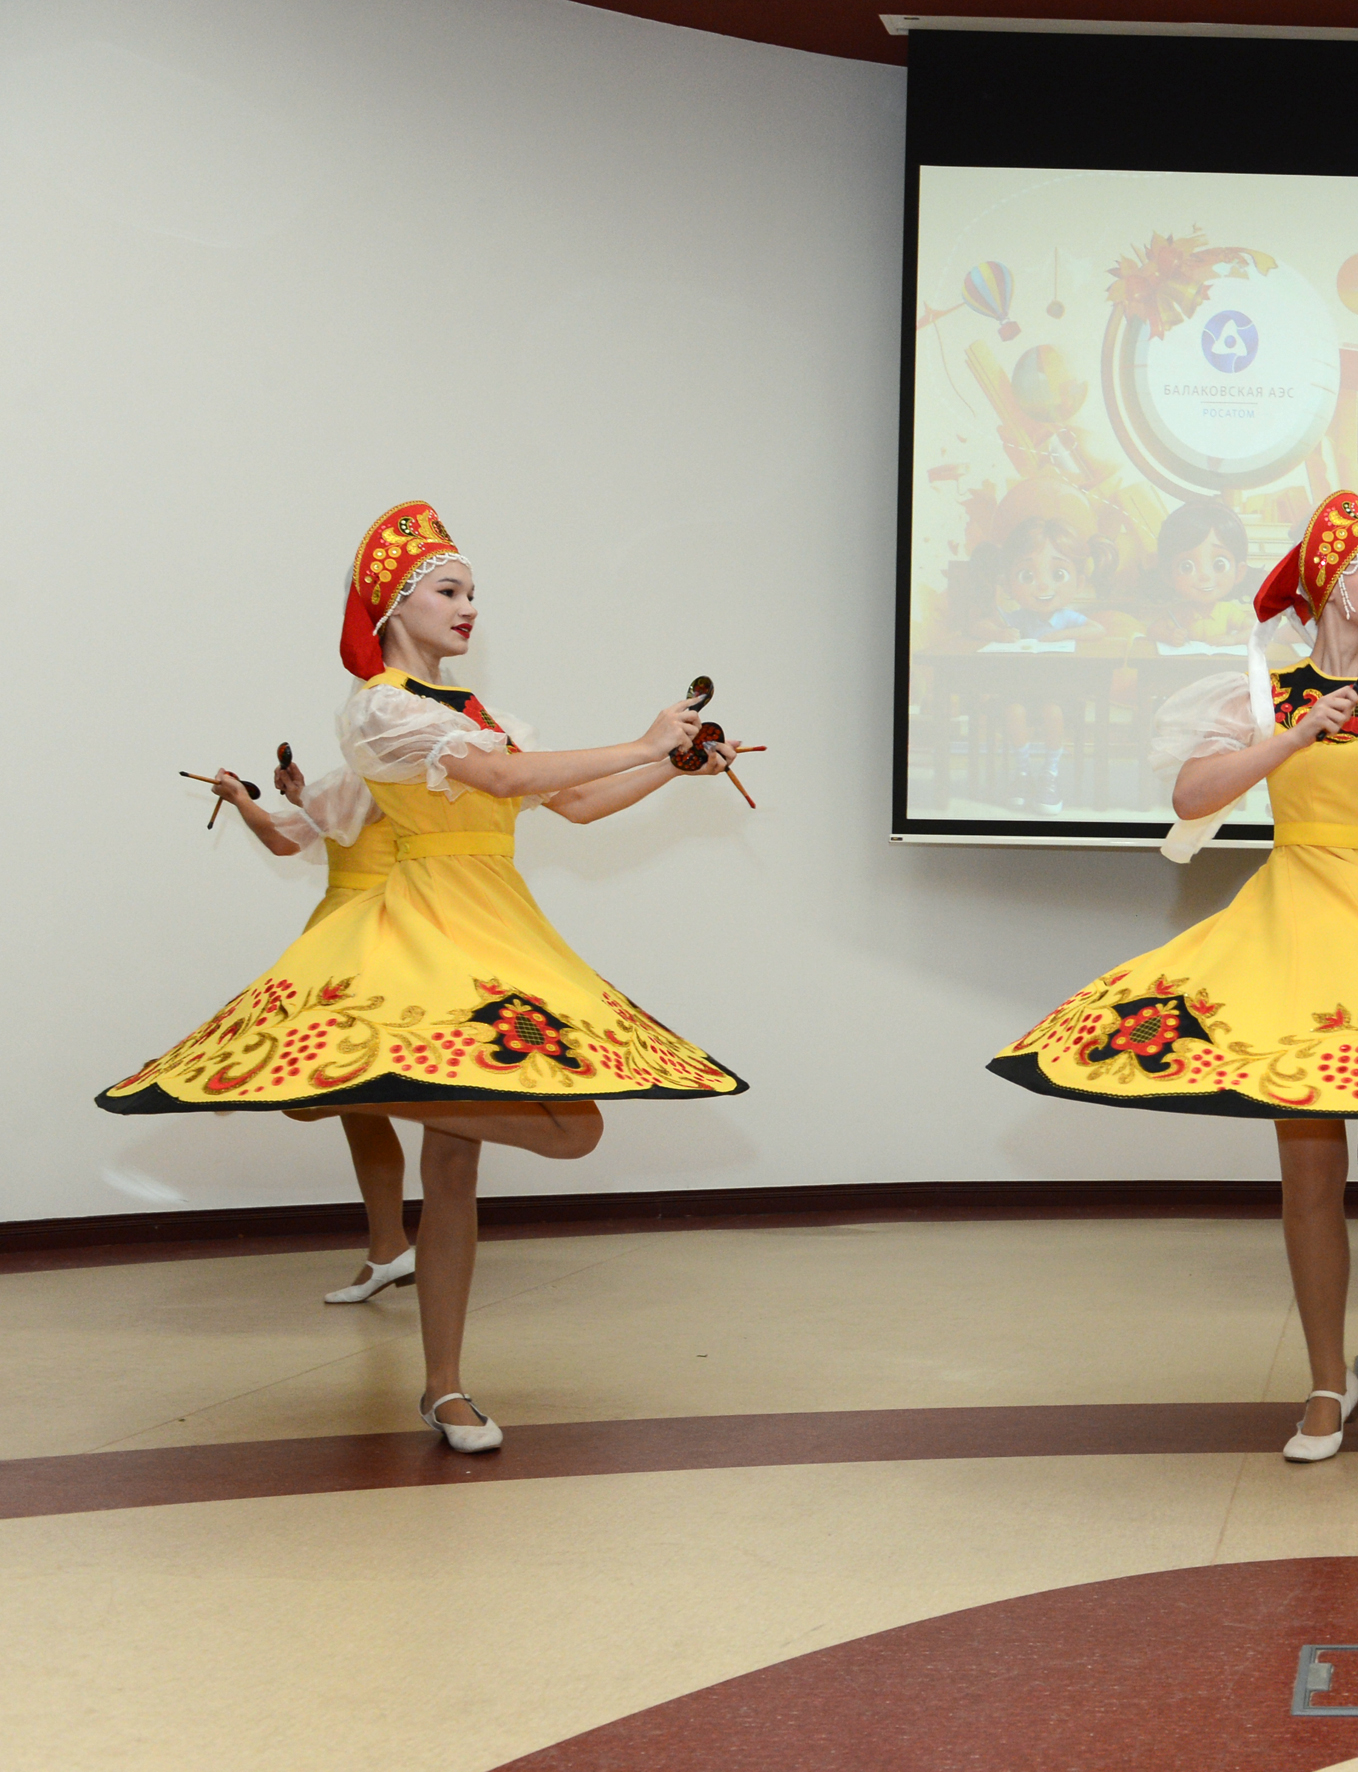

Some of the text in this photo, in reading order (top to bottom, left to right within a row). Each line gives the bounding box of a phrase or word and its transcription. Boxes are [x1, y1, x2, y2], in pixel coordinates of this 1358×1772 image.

[1163, 384, 1295, 399] БАЛАКОВСКАЯ АЭС
[1203, 408, 1255, 419] РОСАТОМ
